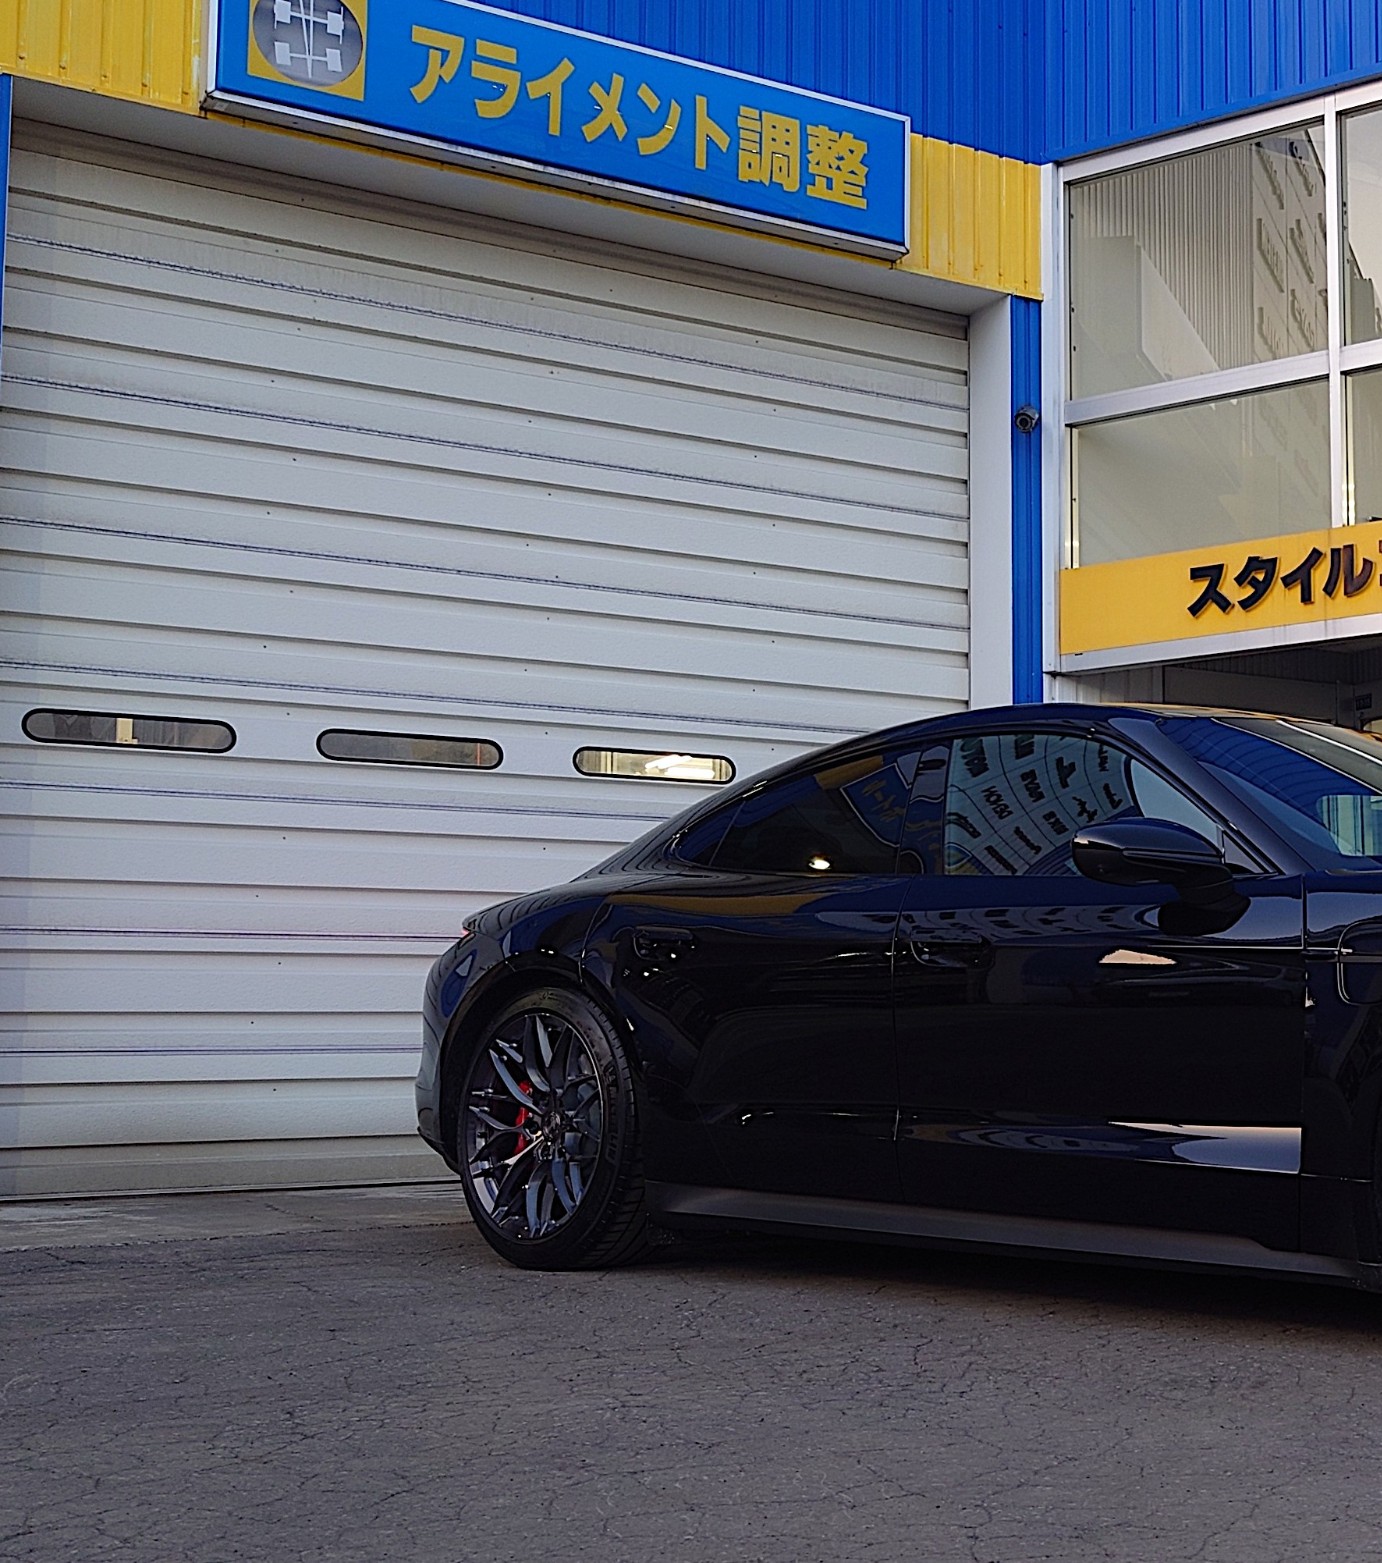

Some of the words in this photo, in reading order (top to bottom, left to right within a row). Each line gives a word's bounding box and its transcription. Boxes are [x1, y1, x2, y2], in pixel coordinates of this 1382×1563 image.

[409, 24, 870, 212] アライメント調整
